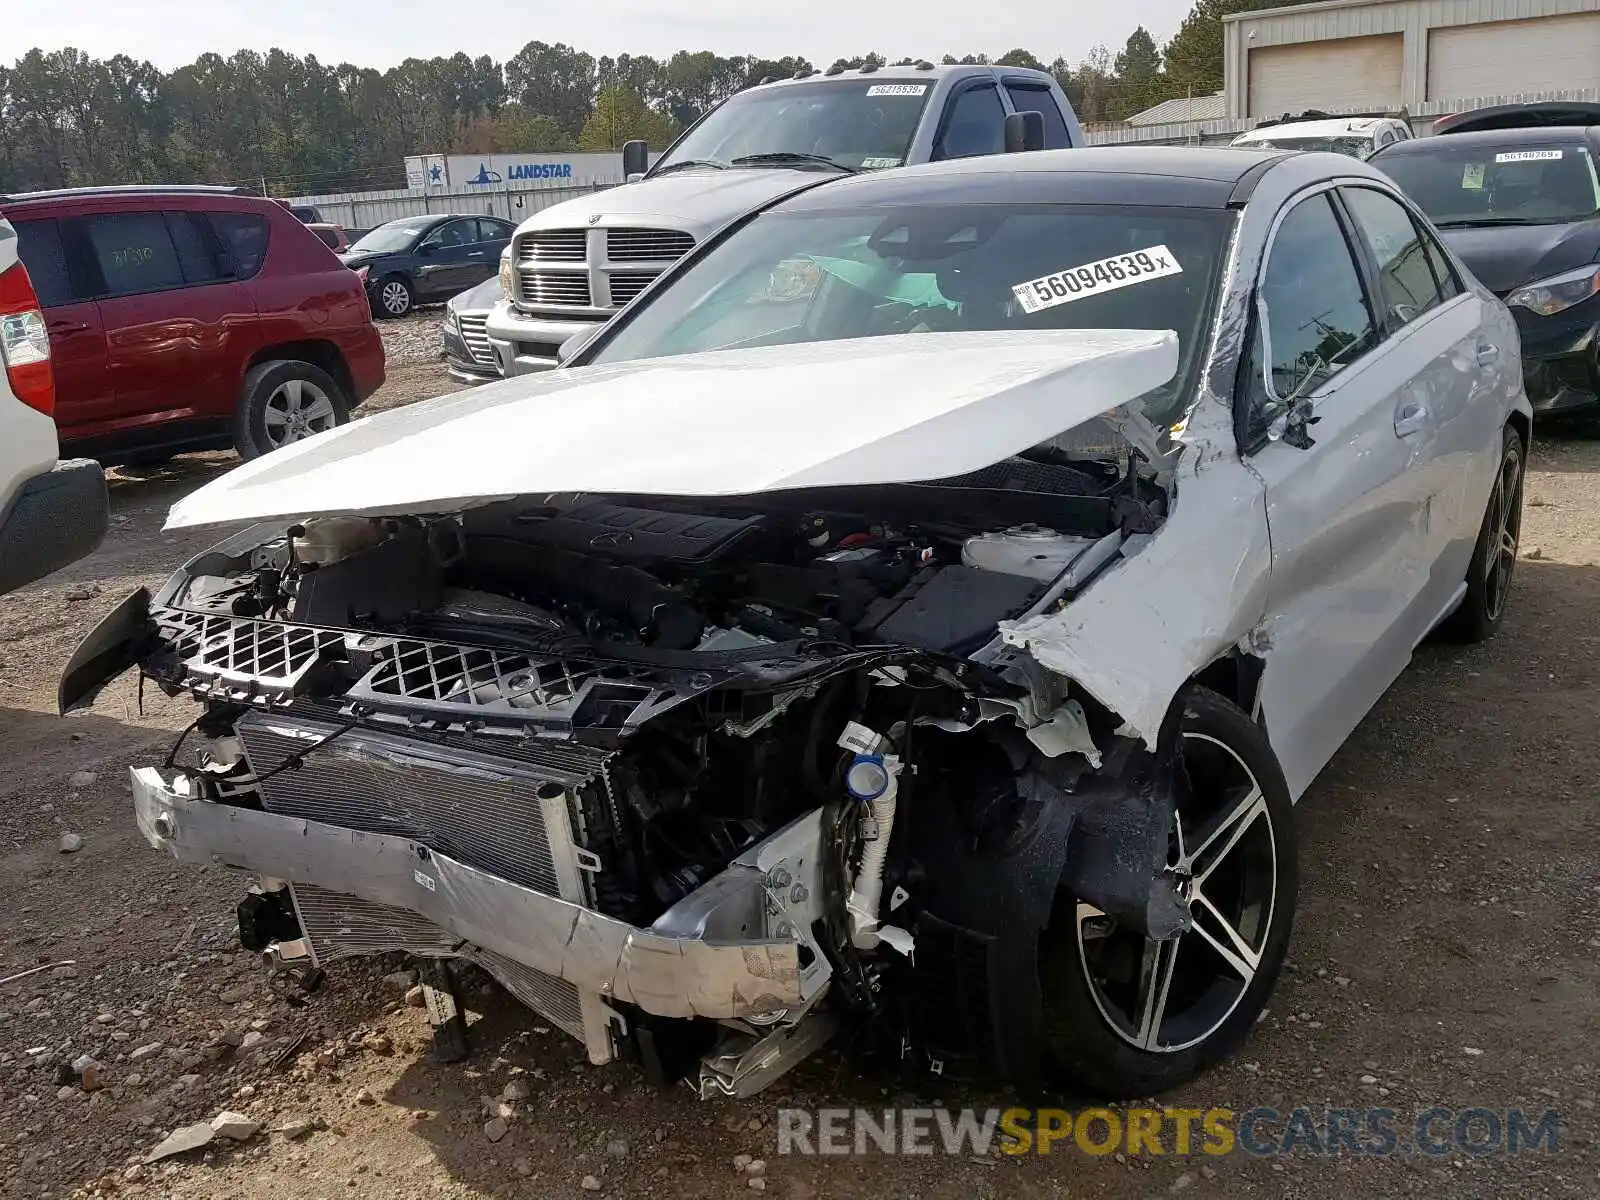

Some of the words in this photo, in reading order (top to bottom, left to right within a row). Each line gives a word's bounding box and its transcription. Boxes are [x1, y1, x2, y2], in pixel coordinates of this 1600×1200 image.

[508, 165, 571, 179] LANDSTAR
[515, 195, 523, 208] J
[1032, 252, 1156, 302] 56094639
